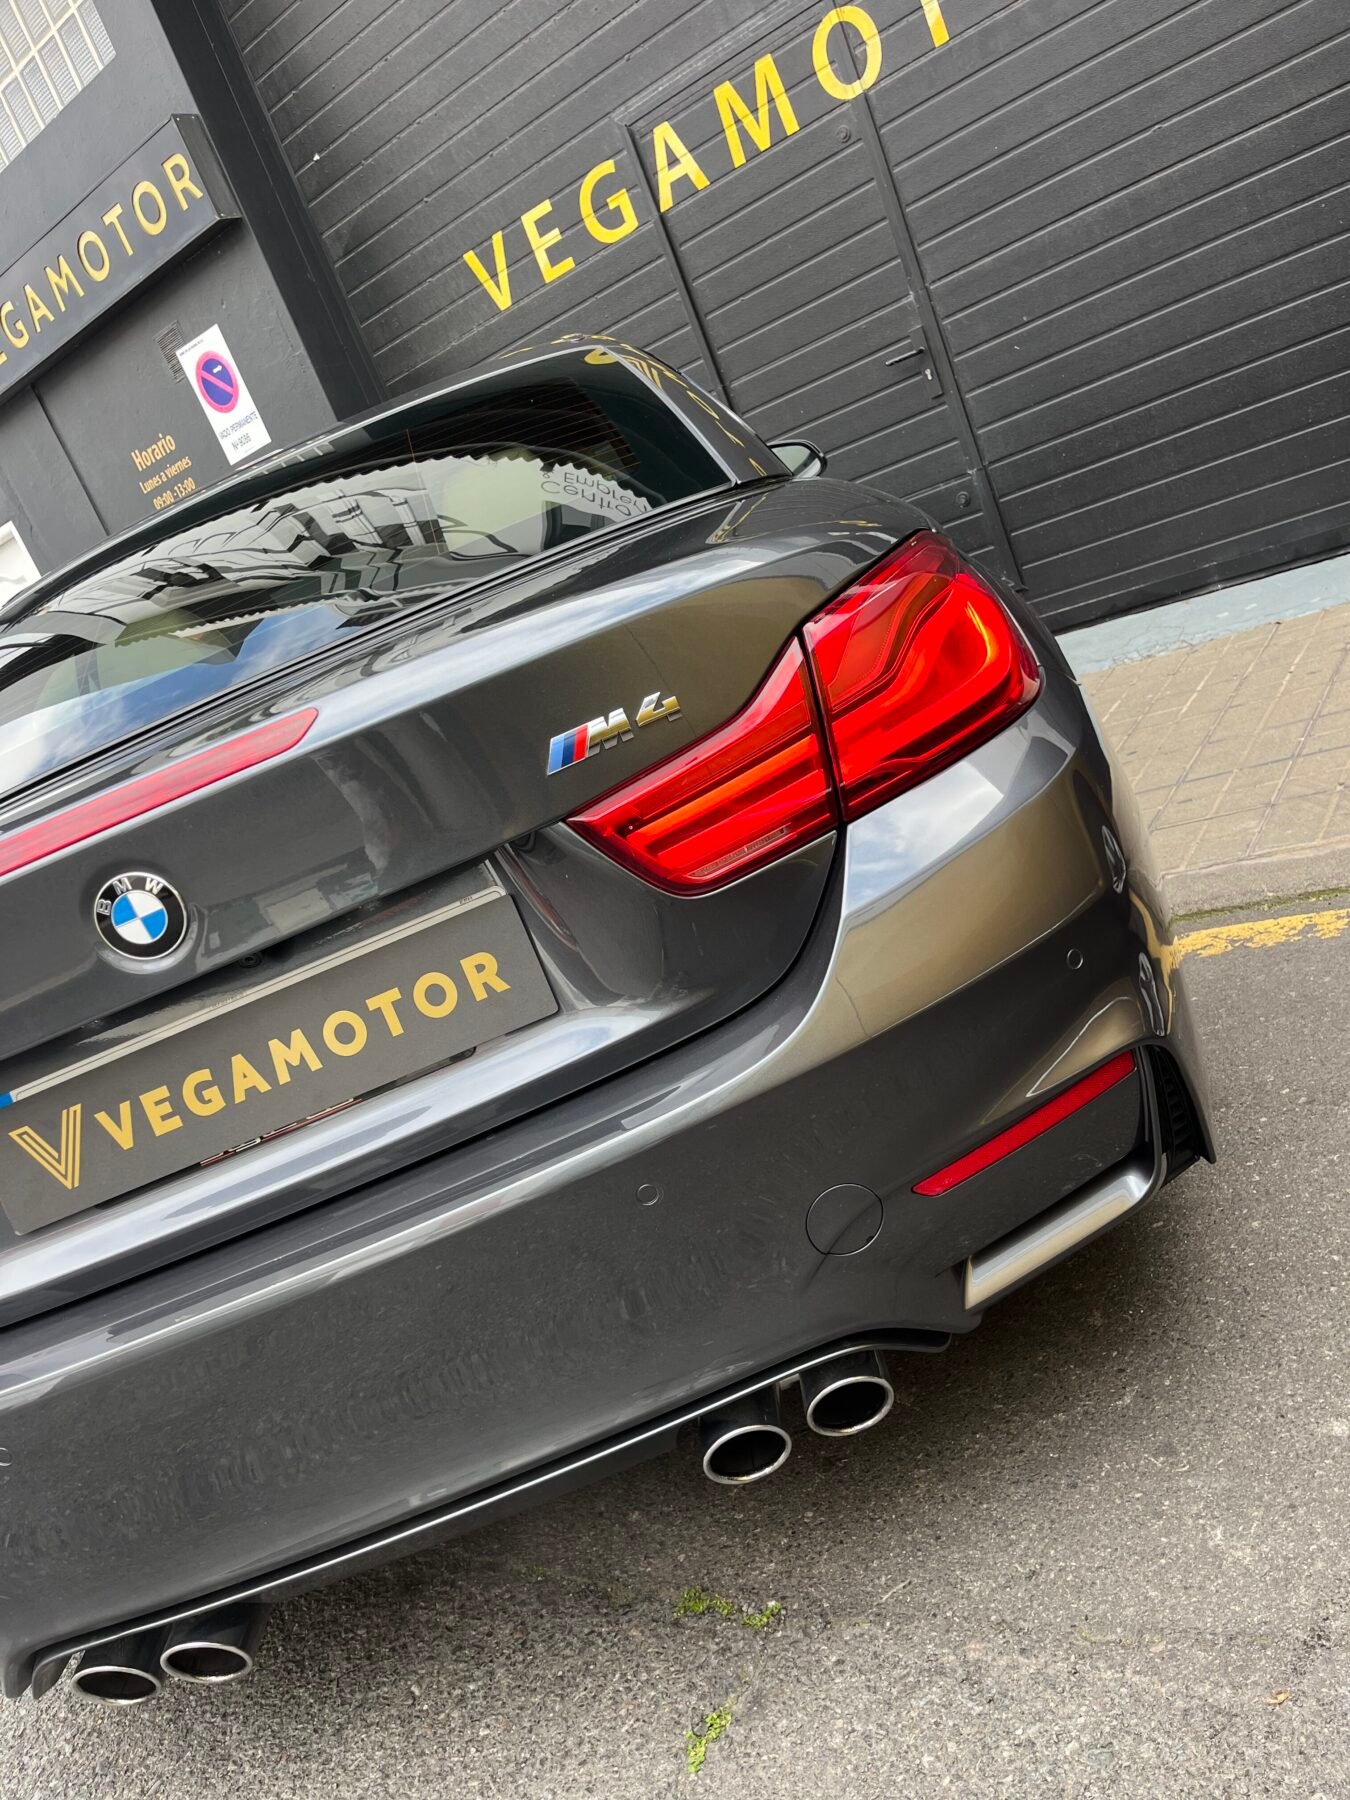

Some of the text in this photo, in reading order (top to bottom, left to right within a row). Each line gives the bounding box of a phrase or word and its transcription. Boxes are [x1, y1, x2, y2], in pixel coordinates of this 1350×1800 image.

[0, 153, 203, 366] GAMOTOR
[131, 432, 176, 472] Horario
[139, 456, 192, 495] Lunes a viernes
[153, 490, 175, 511] 09:00
[174, 477, 196, 498] 13:00
[586, 691, 684, 758] M4
[97, 877, 164, 916] BMW
[94, 951, 511, 1151] VEGAMOTOR
